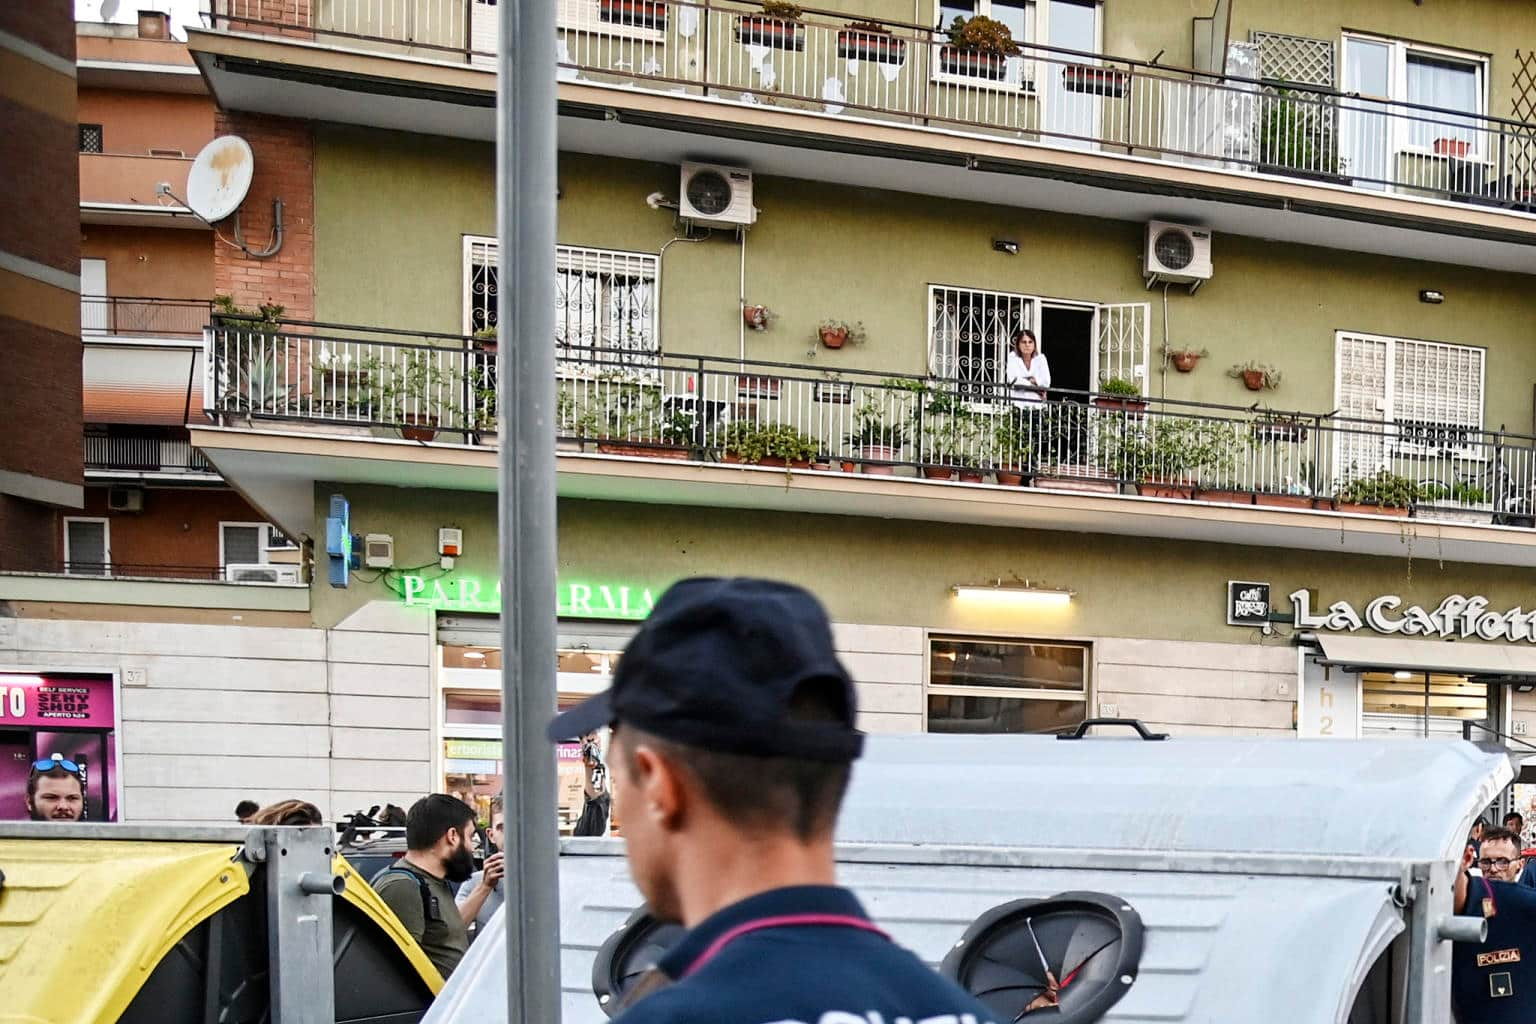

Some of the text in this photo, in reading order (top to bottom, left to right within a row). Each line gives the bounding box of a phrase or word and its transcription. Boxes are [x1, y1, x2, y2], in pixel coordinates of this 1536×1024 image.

[1289, 588, 1363, 632] La
[38, 703, 89, 711] SHOP
[1479, 950, 1520, 965] POLIZIA
